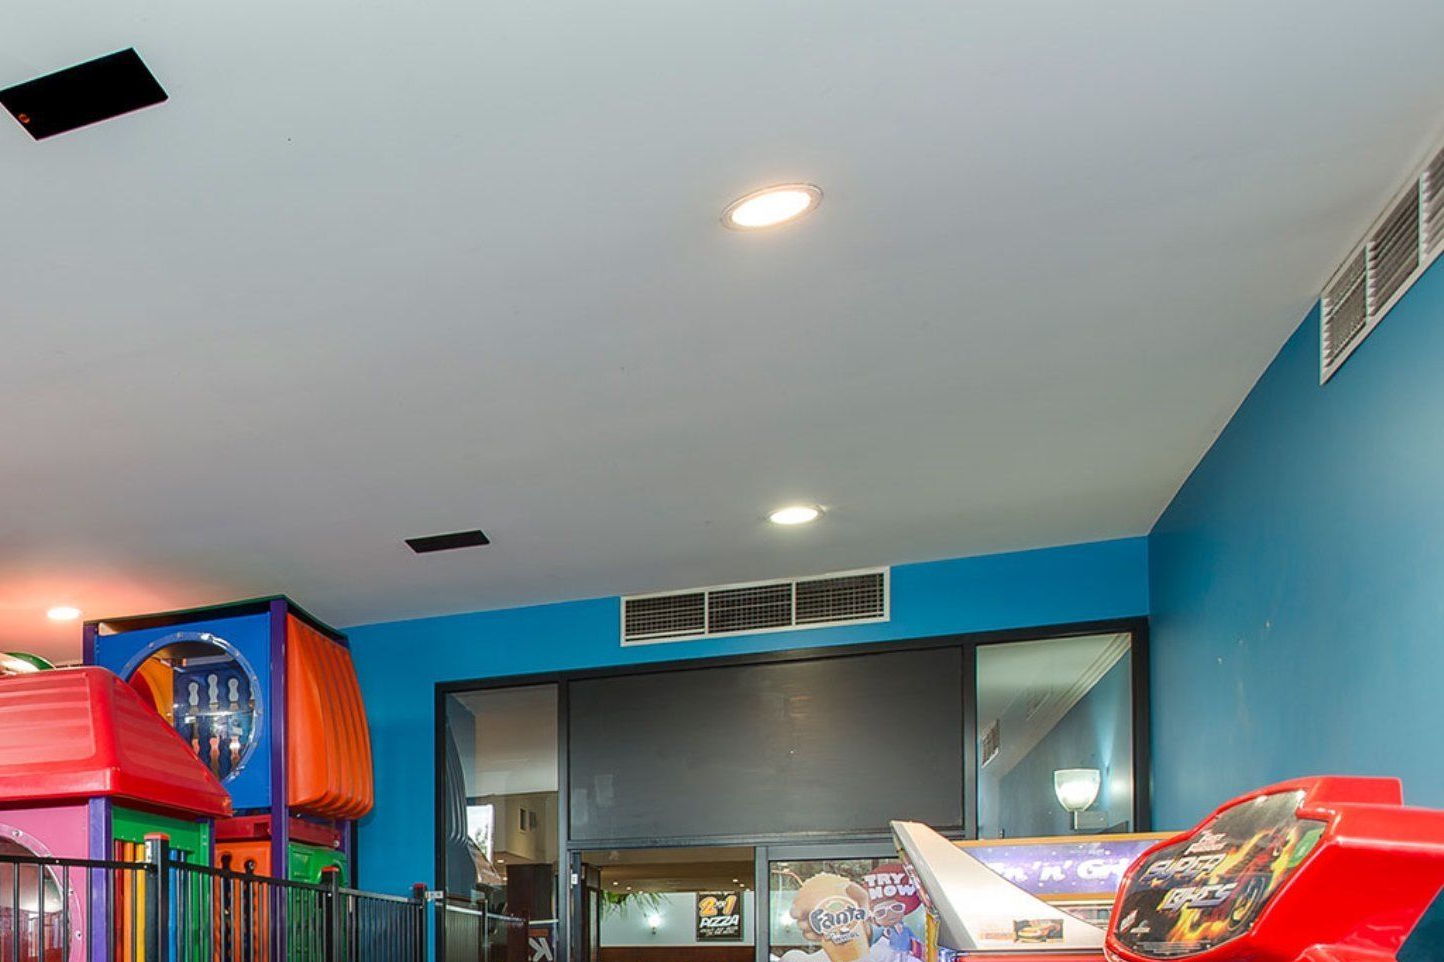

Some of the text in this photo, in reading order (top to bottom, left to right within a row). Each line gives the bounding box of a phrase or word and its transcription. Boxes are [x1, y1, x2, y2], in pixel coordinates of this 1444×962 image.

[863, 873, 906, 887] TRY
[868, 884, 917, 900] NOW
[699, 914, 739, 928] PIZZA
[809, 906, 867, 934] Fanta
